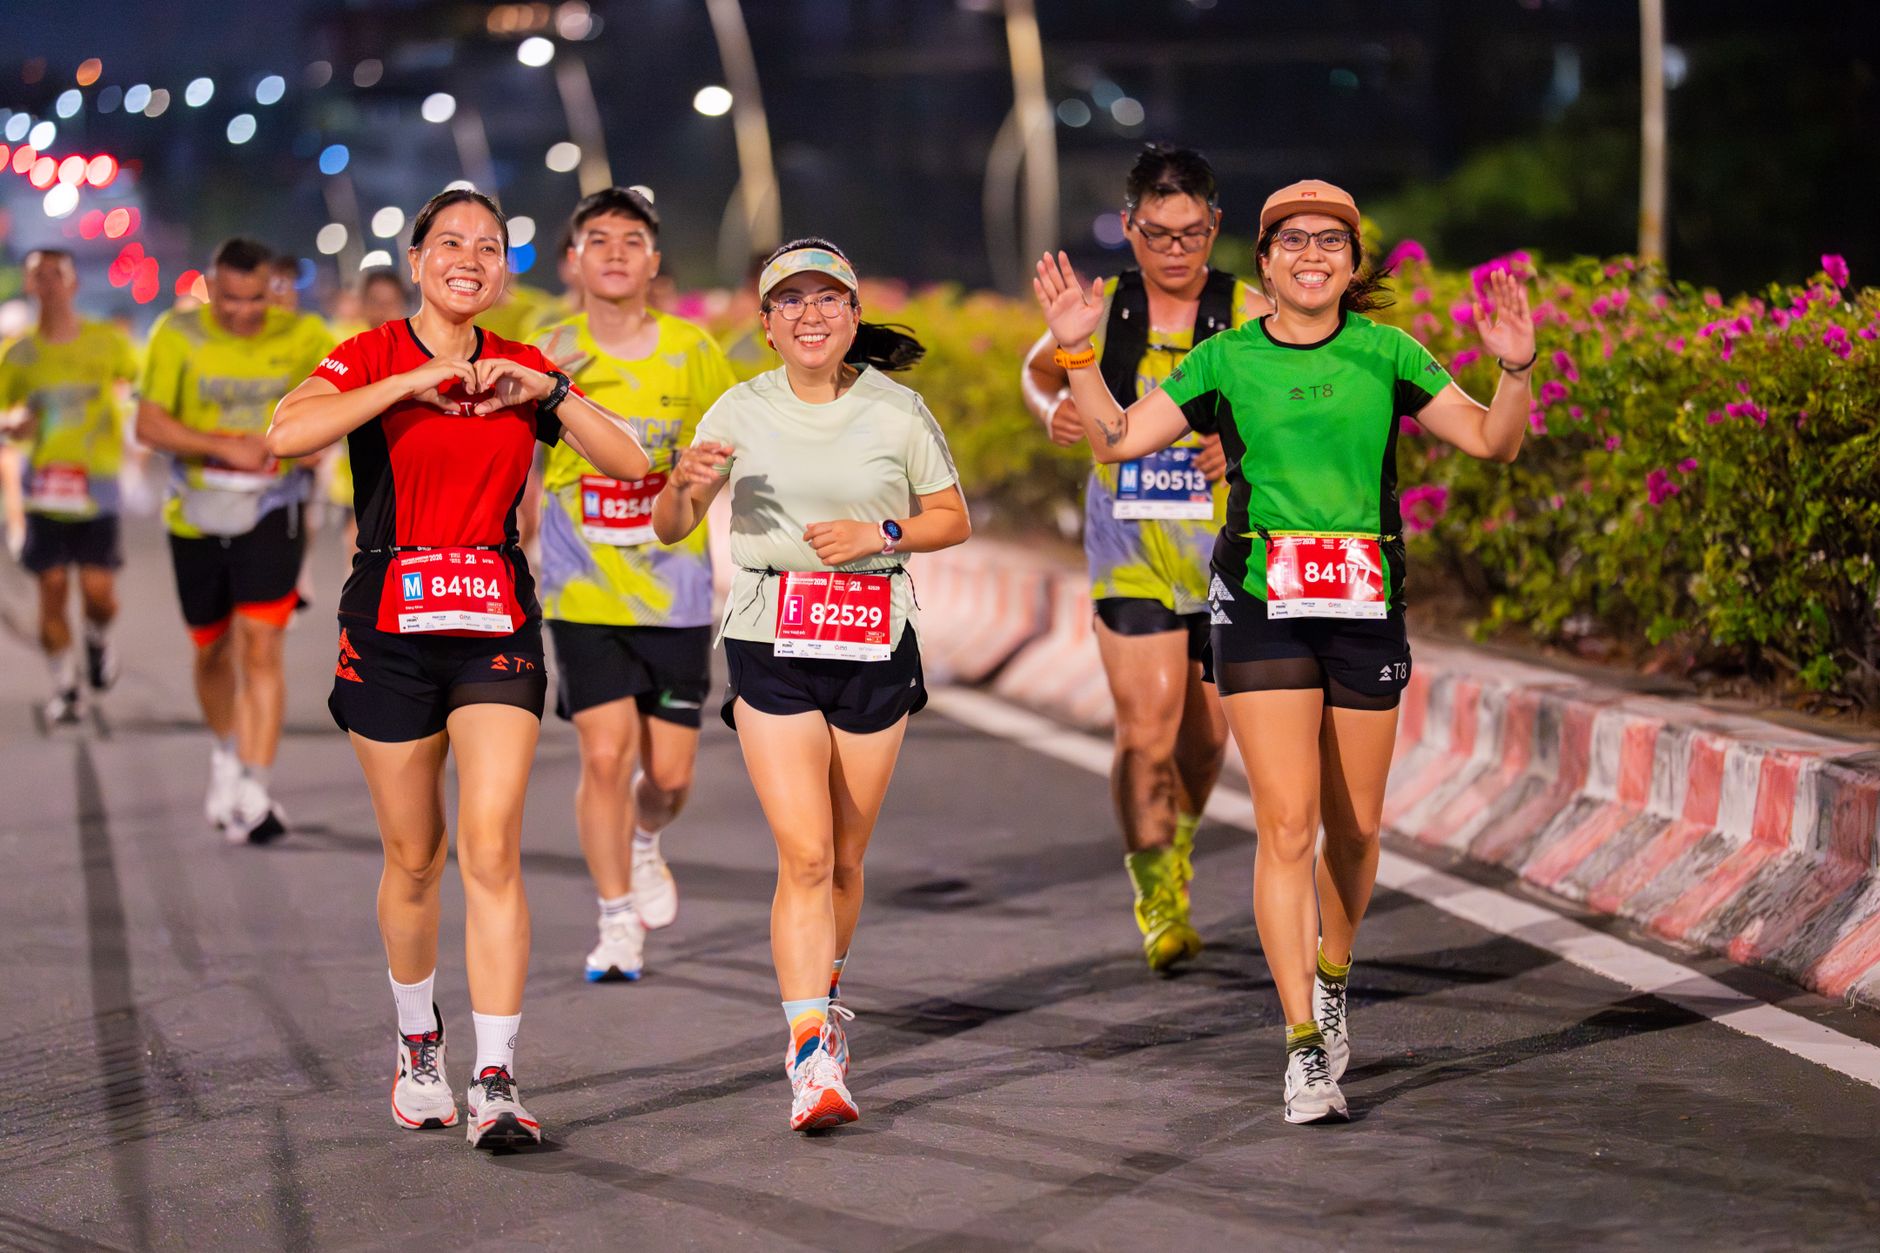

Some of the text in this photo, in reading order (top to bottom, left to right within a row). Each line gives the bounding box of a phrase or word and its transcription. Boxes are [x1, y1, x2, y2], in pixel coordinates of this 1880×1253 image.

[1308, 383, 1334, 400] T8
[1140, 469, 1206, 491] 90513
[602, 498, 656, 519] 8254
[1304, 561, 1371, 585] 84177
[405, 575, 501, 599] M 84184
[788, 599, 883, 629] F 82529
[1393, 662, 1408, 680] T8
